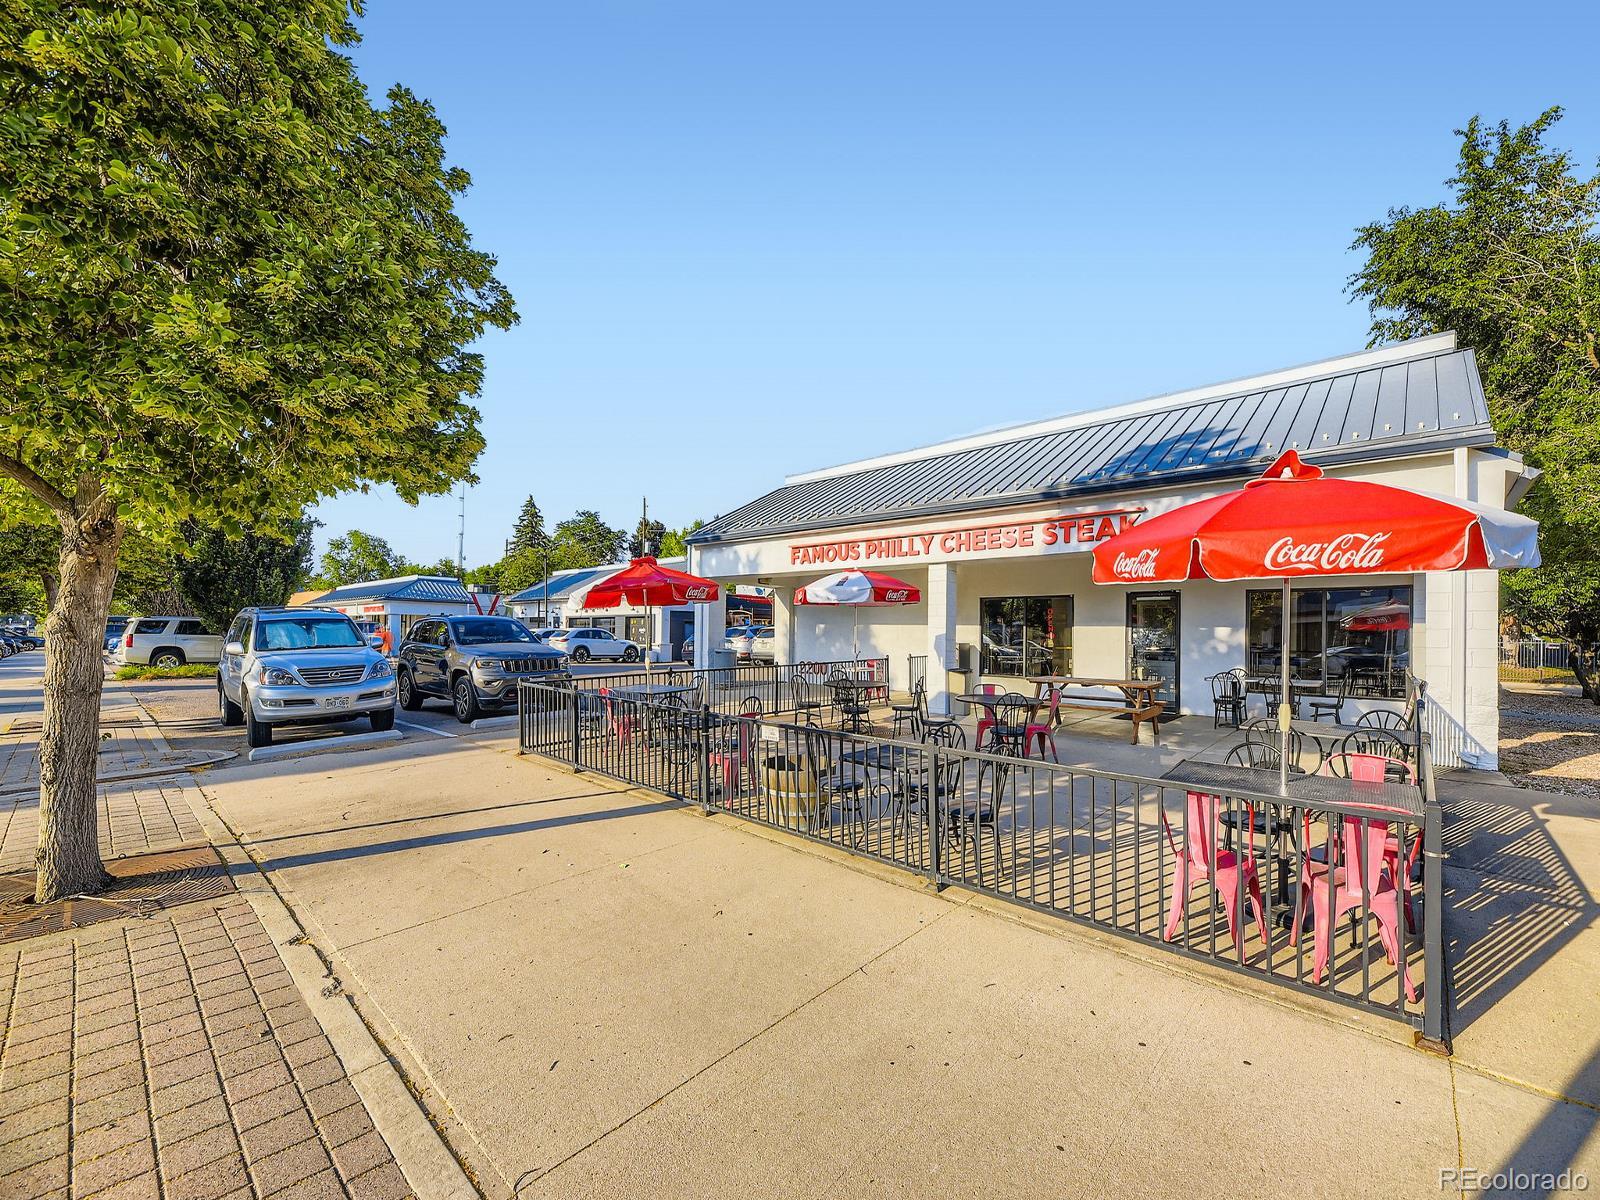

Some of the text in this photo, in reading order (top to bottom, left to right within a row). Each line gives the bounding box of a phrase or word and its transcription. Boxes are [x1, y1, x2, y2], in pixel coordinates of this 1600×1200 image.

[791, 543, 860, 565] FAMOUS
[865, 535, 935, 559] PHILLY
[939, 525, 1034, 553] CHEESE
[1264, 531, 1392, 570] Coca-Cola
